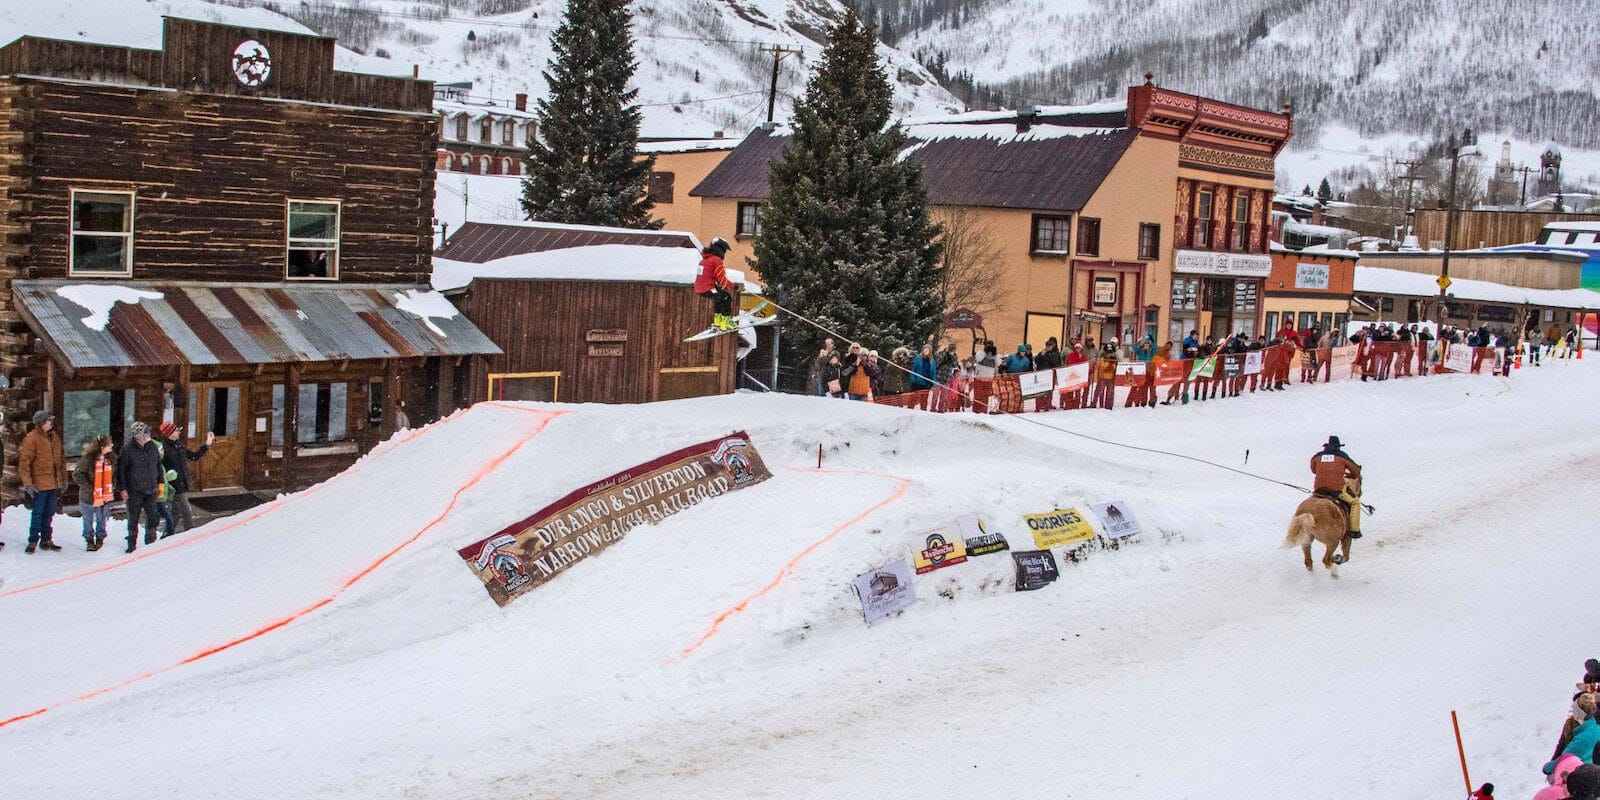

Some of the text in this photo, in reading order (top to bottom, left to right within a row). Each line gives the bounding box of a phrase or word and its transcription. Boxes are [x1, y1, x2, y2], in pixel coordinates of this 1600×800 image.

[533, 526, 602, 577] NARROW
[646, 476, 729, 521] RAILROAD
[534, 499, 610, 548] DURANGO
[610, 495, 625, 512] &
[622, 461, 707, 506] SILVERTON
